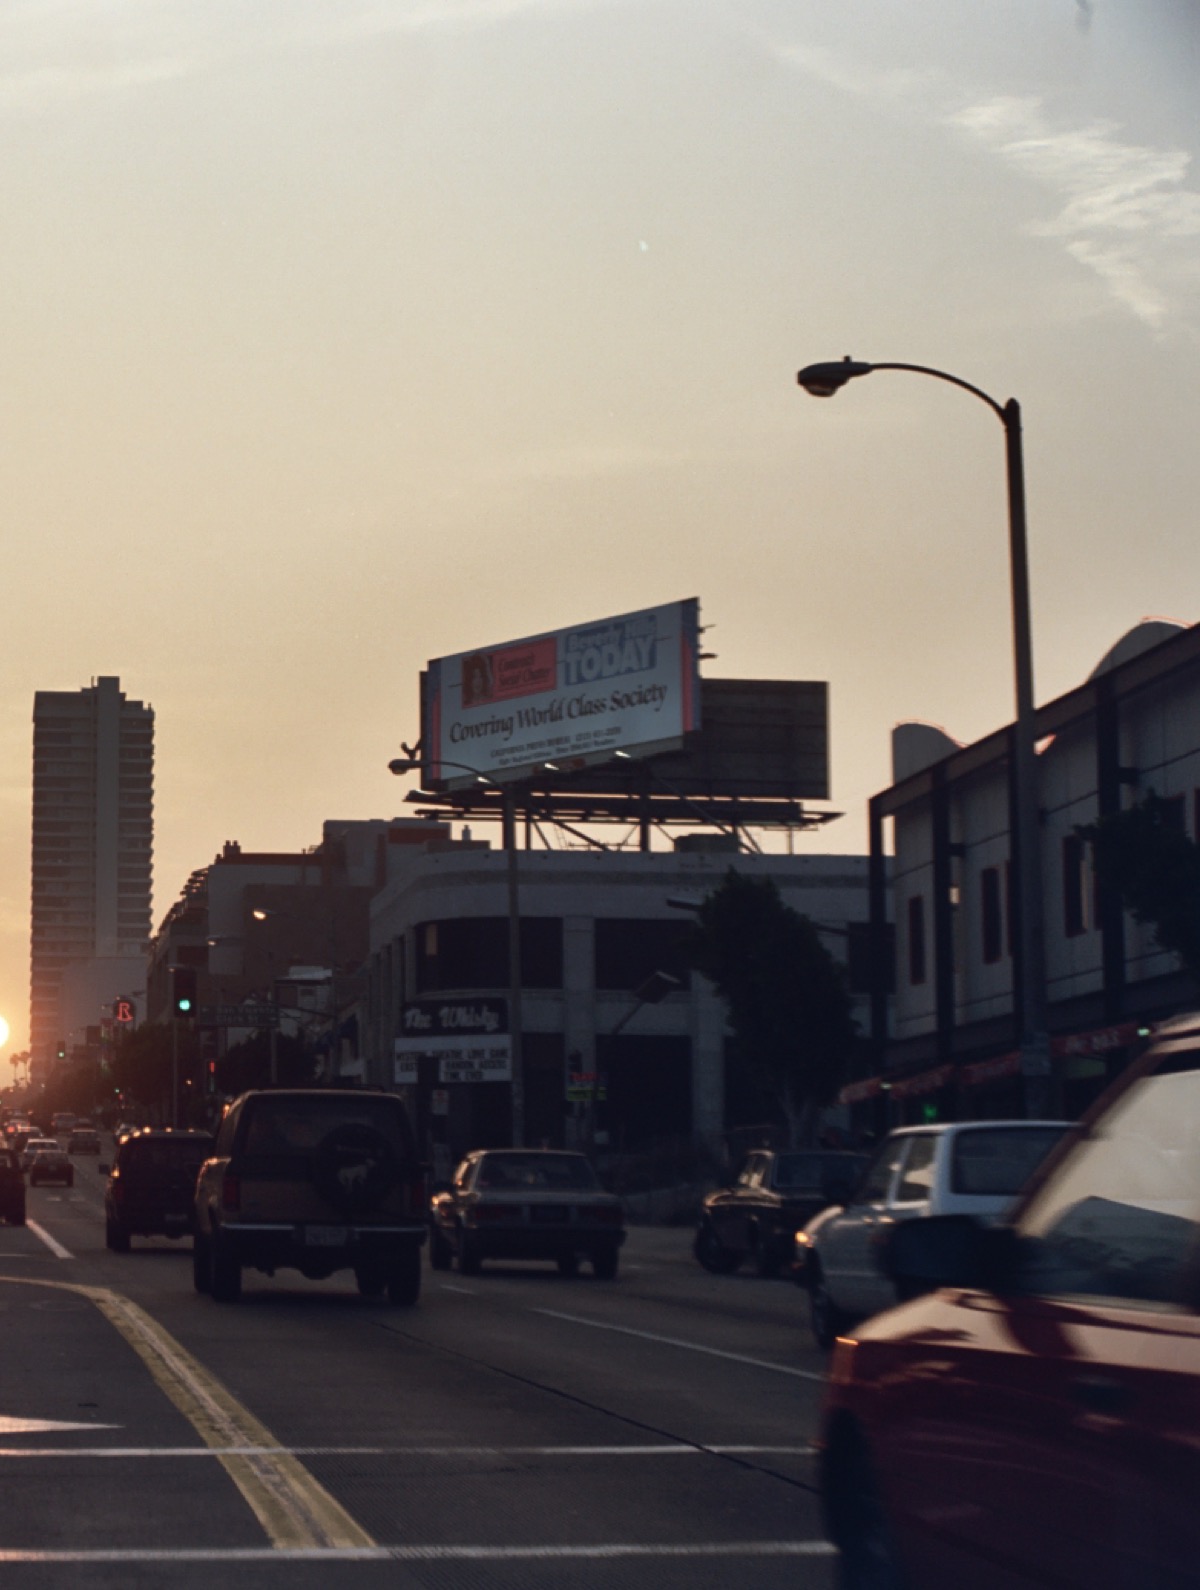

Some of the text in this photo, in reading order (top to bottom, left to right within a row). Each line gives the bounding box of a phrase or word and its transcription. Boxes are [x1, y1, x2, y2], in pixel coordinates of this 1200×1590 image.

[566, 637, 656, 686] TODAY
[450, 683, 668, 744] Covering World Class Society
[116, 1002, 134, 1021] R
[404, 1003, 500, 1032] The Whisky
